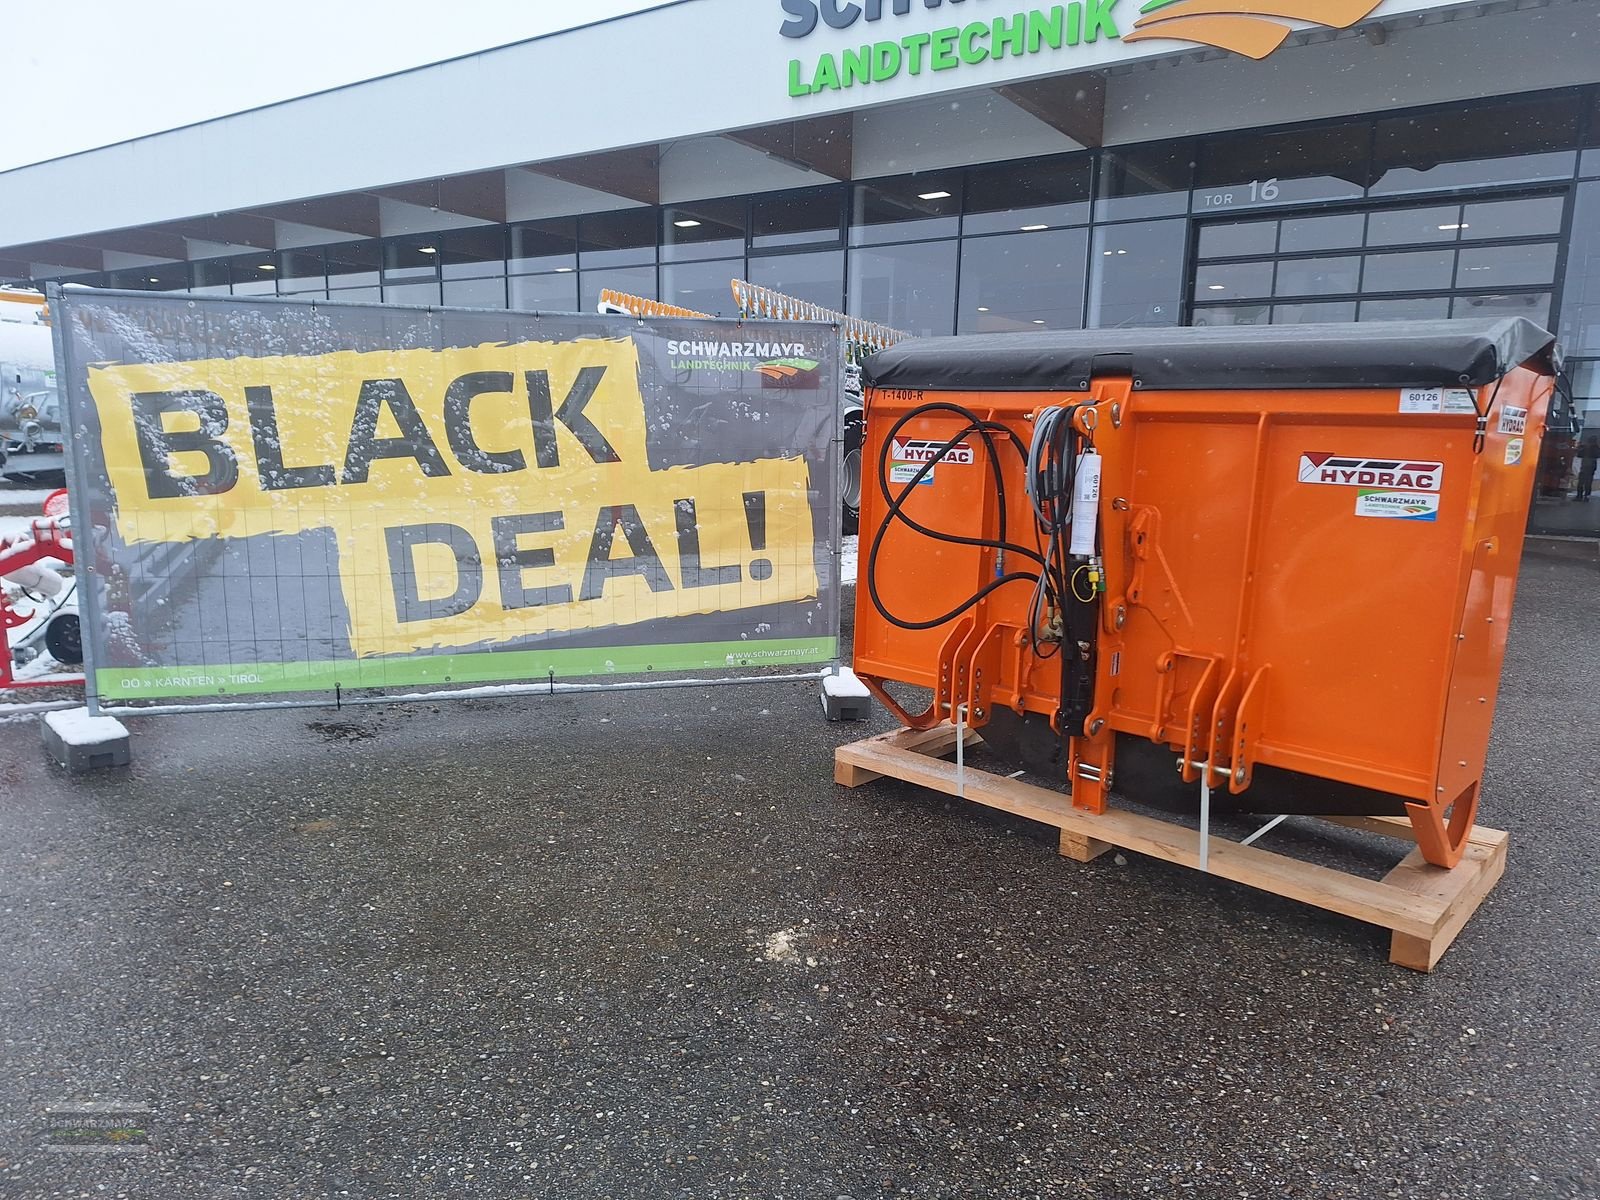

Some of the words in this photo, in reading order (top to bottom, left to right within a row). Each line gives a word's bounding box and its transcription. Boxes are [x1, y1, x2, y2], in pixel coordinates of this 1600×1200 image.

[788, 0, 1120, 97] LANDTECHNIK
[1204, 193, 1233, 206] TOR
[1248, 178, 1279, 201] 16
[667, 340, 805, 358] SCHWARZMAYR
[670, 359, 751, 371] LANDTECHNIK
[882, 390, 924, 400] T-1400-R
[1409, 393, 1438, 401] 60126
[132, 364, 622, 500] BLACK
[904, 449, 969, 463] HYDAC
[1320, 469, 1434, 489] HYDRAC
[1364, 495, 1427, 505] SCHWARZMAYR
[385, 490, 774, 625] DEAL!
[727, 647, 819, 659] www.schwarzmayr.at
[229, 674, 264, 684] TIROL
